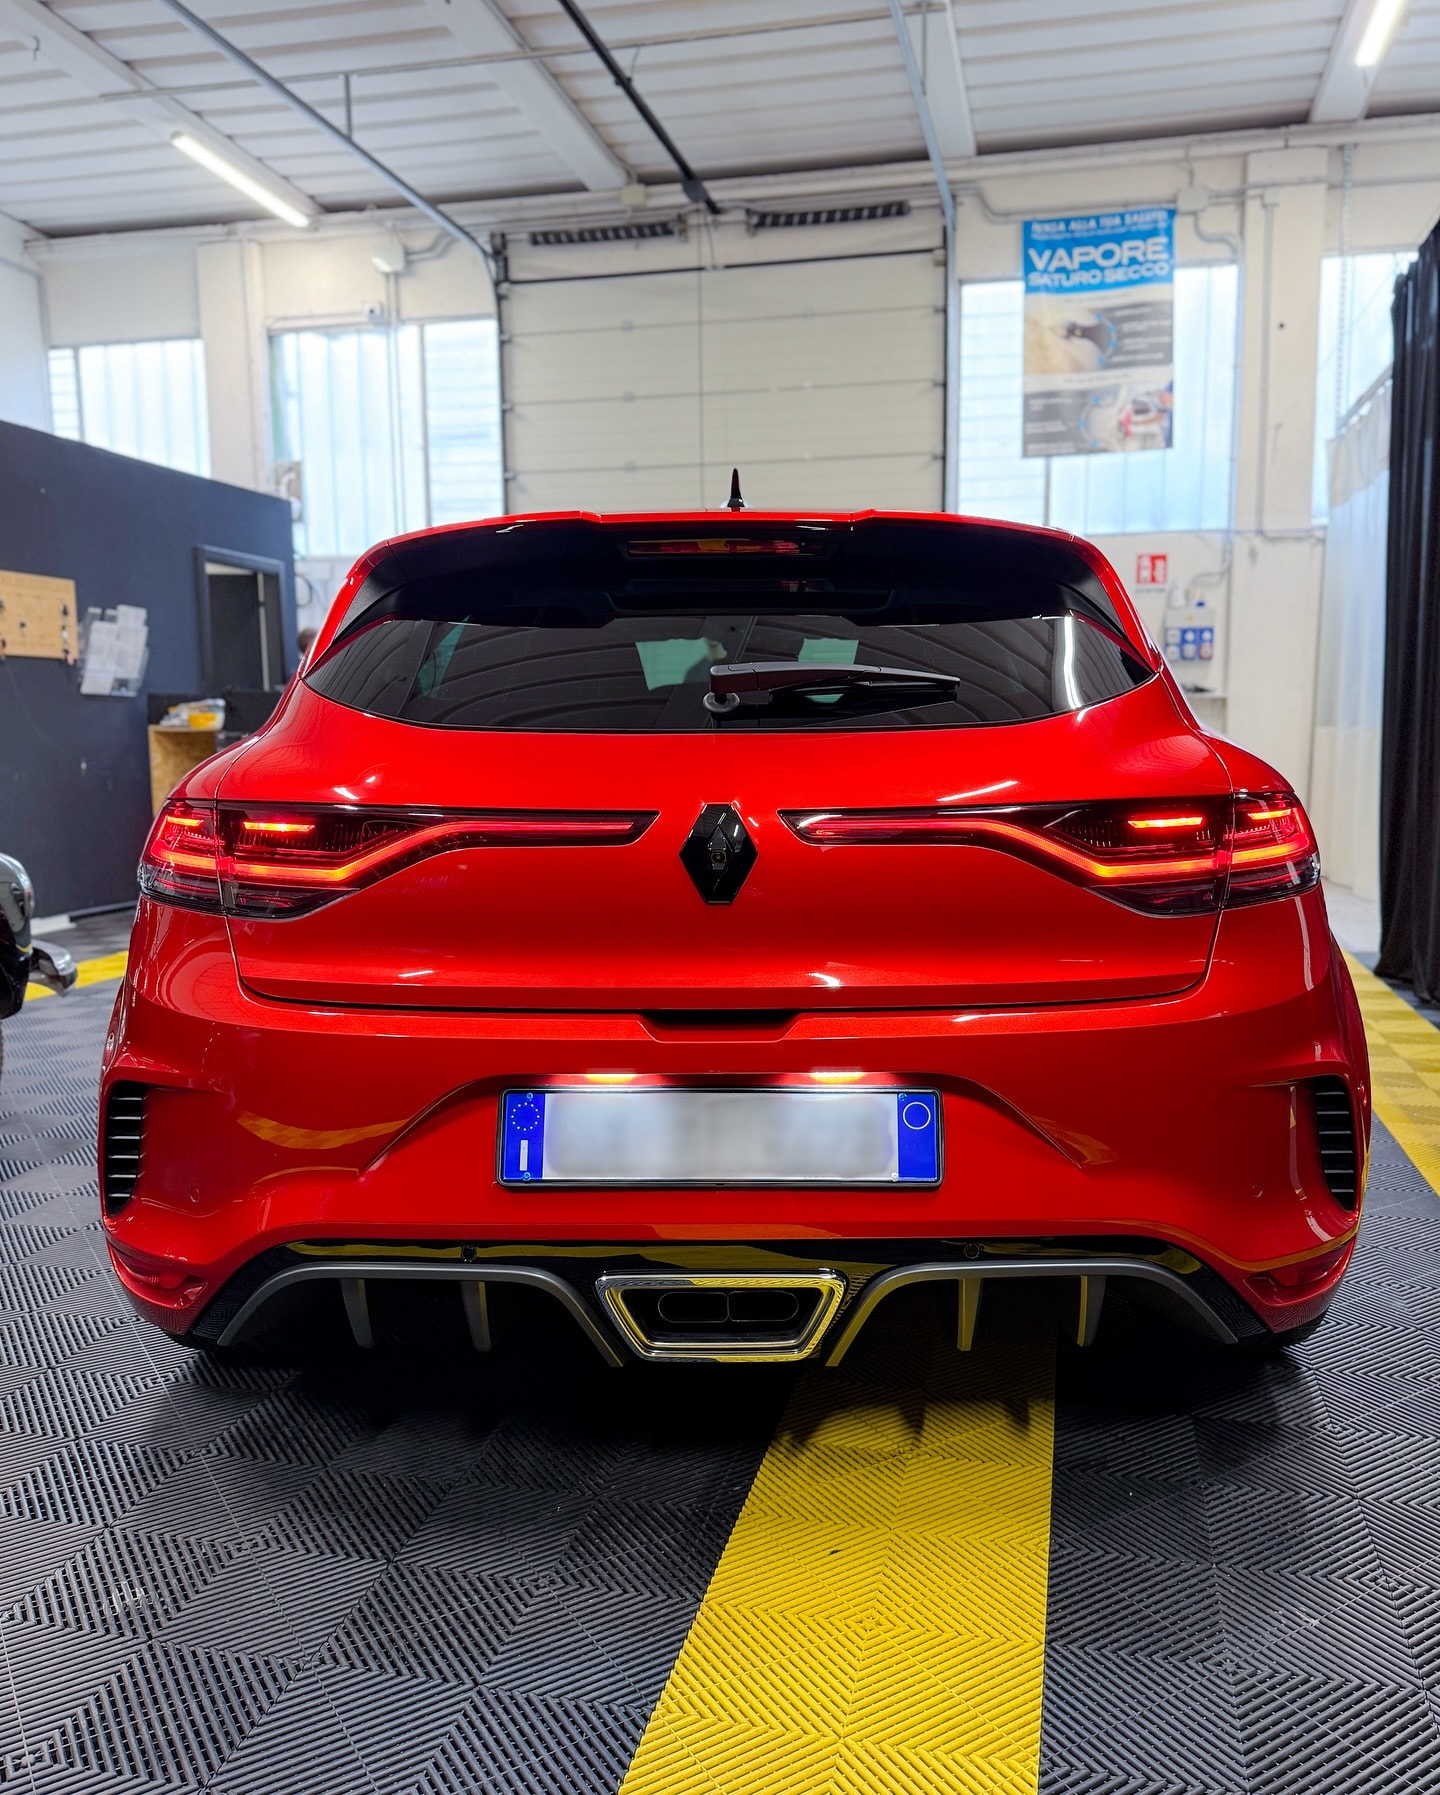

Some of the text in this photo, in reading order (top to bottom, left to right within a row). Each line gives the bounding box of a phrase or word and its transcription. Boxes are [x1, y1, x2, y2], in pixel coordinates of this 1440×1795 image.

[1028, 235, 1170, 272] VAPORE
[1027, 261, 1170, 288] SATURO SECCO
